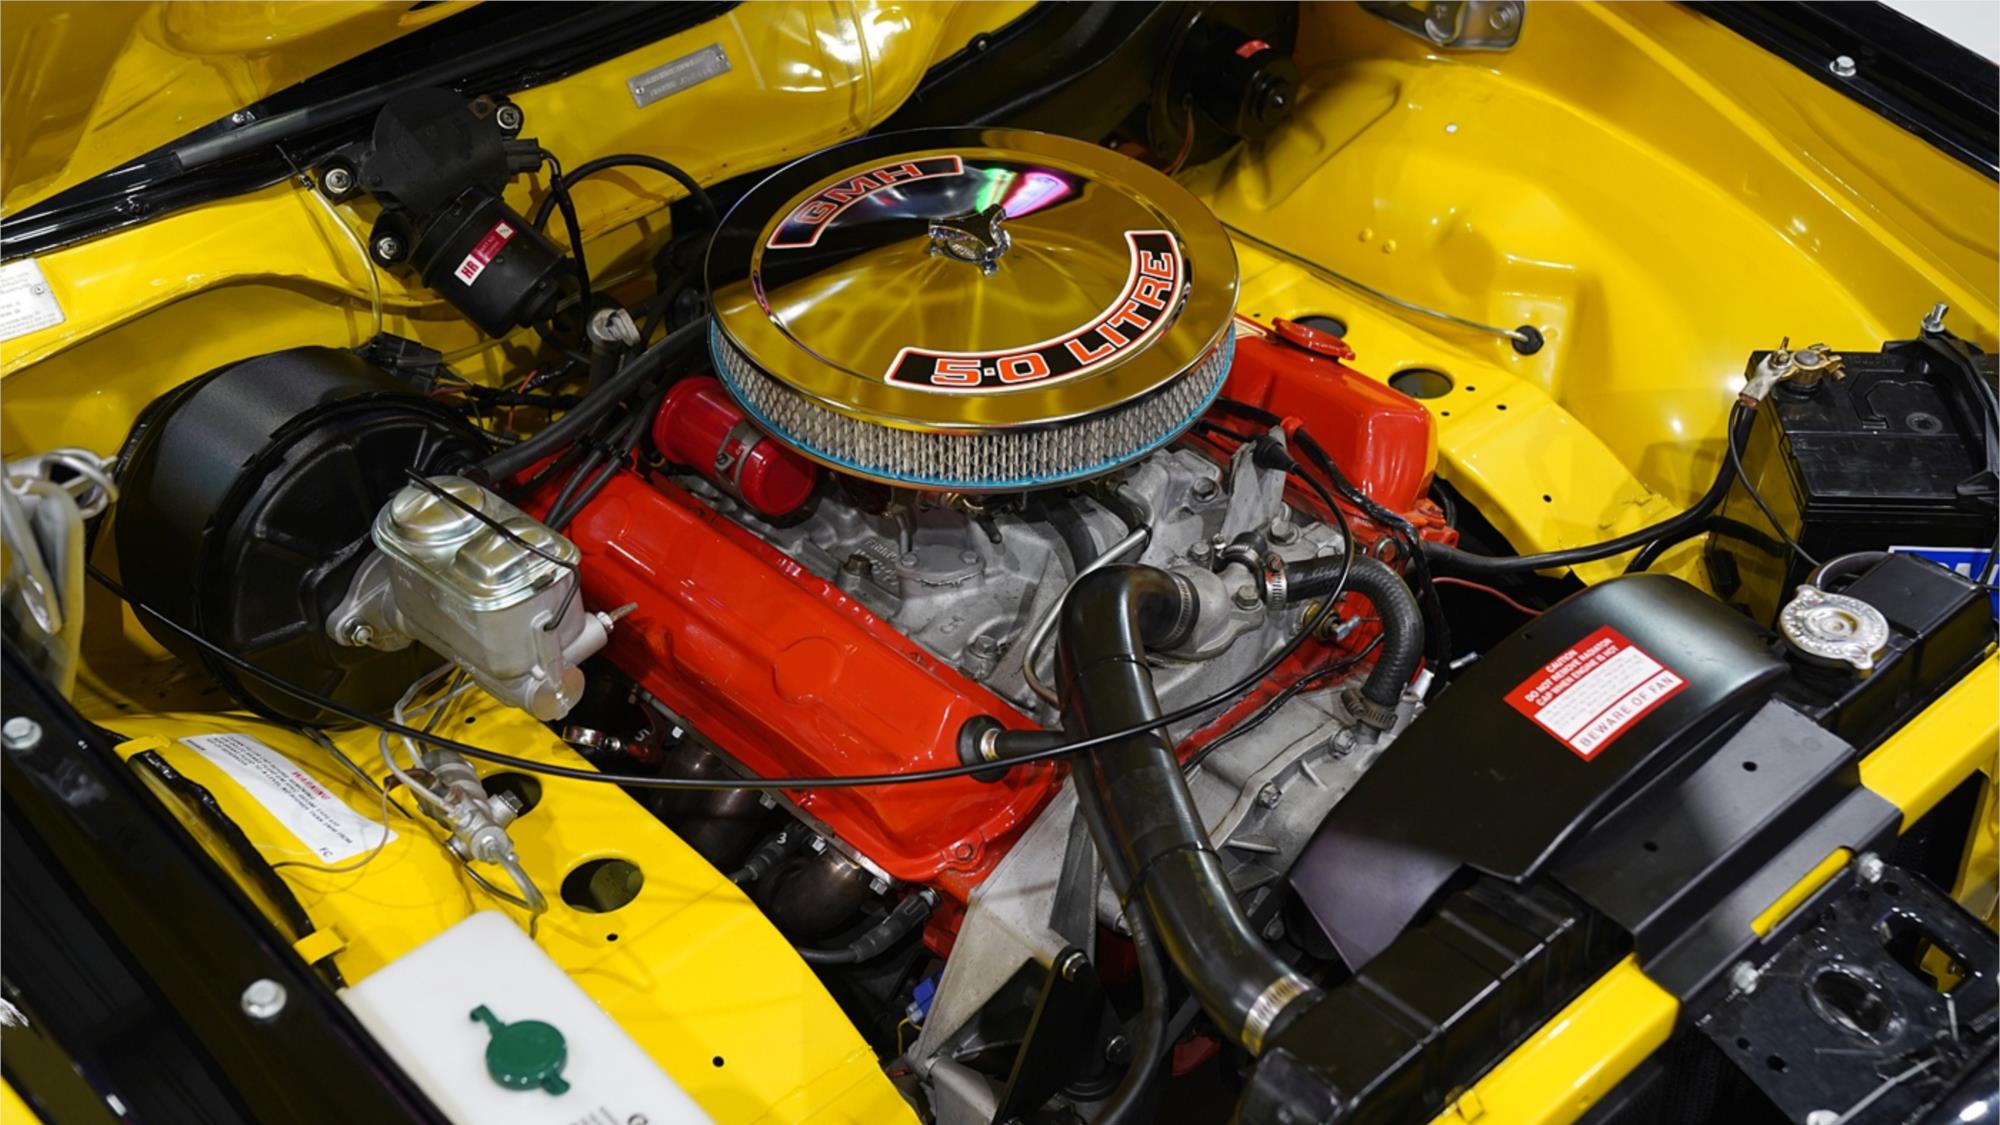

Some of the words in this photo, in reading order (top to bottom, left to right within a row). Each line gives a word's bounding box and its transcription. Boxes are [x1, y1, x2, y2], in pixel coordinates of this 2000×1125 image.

[794, 163, 923, 224] GMH
[461, 260, 479, 279] HR
[1063, 250, 1174, 365] LITRE
[1524, 690, 1539, 702] DO
[1536, 678, 1554, 694] NOT
[1551, 658, 1582, 682] REMOVE
[1578, 637, 1613, 661] RADIATOR
[1536, 691, 1554, 706] CAP
[1552, 676, 1576, 694] WHEN
[1571, 658, 1599, 680] ENGINE
[1595, 653, 1607, 663] IS
[1545, 649, 1578, 673] CAUTION
[1579, 705, 1630, 747] BEWARE
[1632, 693, 1648, 707] OF
[1650, 676, 1674, 694] FAN
[776, 832, 787, 844] 3
